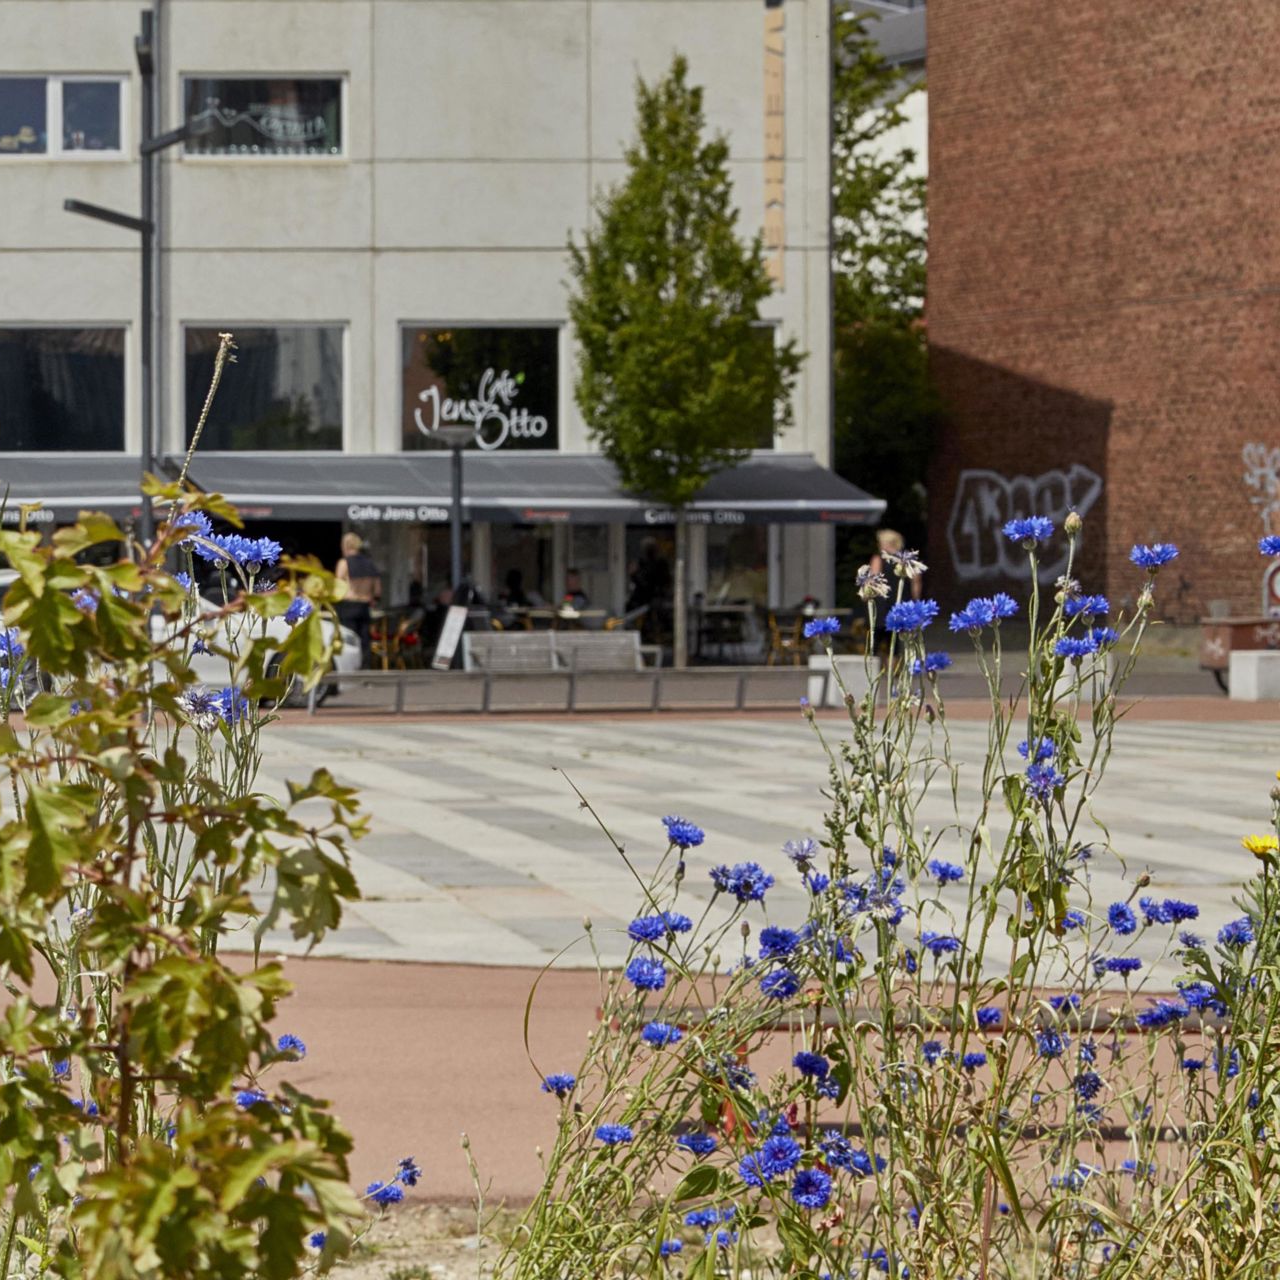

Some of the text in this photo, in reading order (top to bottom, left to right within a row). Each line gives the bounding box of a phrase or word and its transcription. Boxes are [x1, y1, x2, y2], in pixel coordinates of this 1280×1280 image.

[414, 384, 548, 450] Jens Otto
[382, 505, 416, 520] Jens
[417, 506, 449, 521] Otto
